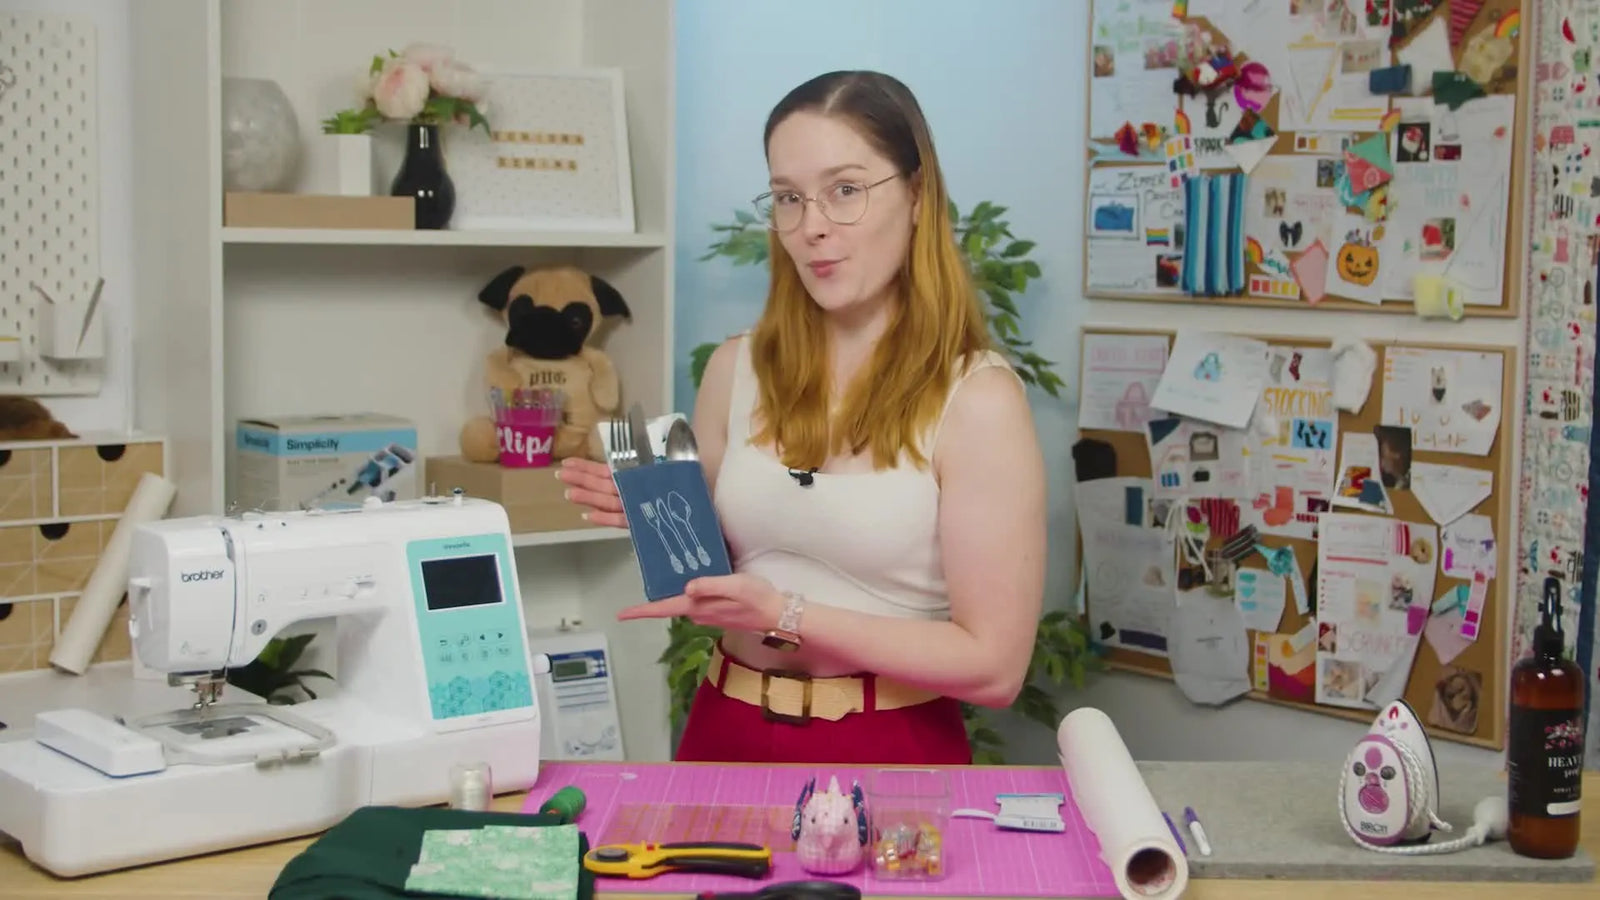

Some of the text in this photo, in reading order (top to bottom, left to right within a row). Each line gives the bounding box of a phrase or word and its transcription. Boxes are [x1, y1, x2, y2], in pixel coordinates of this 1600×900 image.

[1263, 387, 1333, 417] STOCKING
[286, 439, 339, 451] Simplicity
[181, 568, 224, 583] brother
[1548, 755, 1583, 768] HEAV
